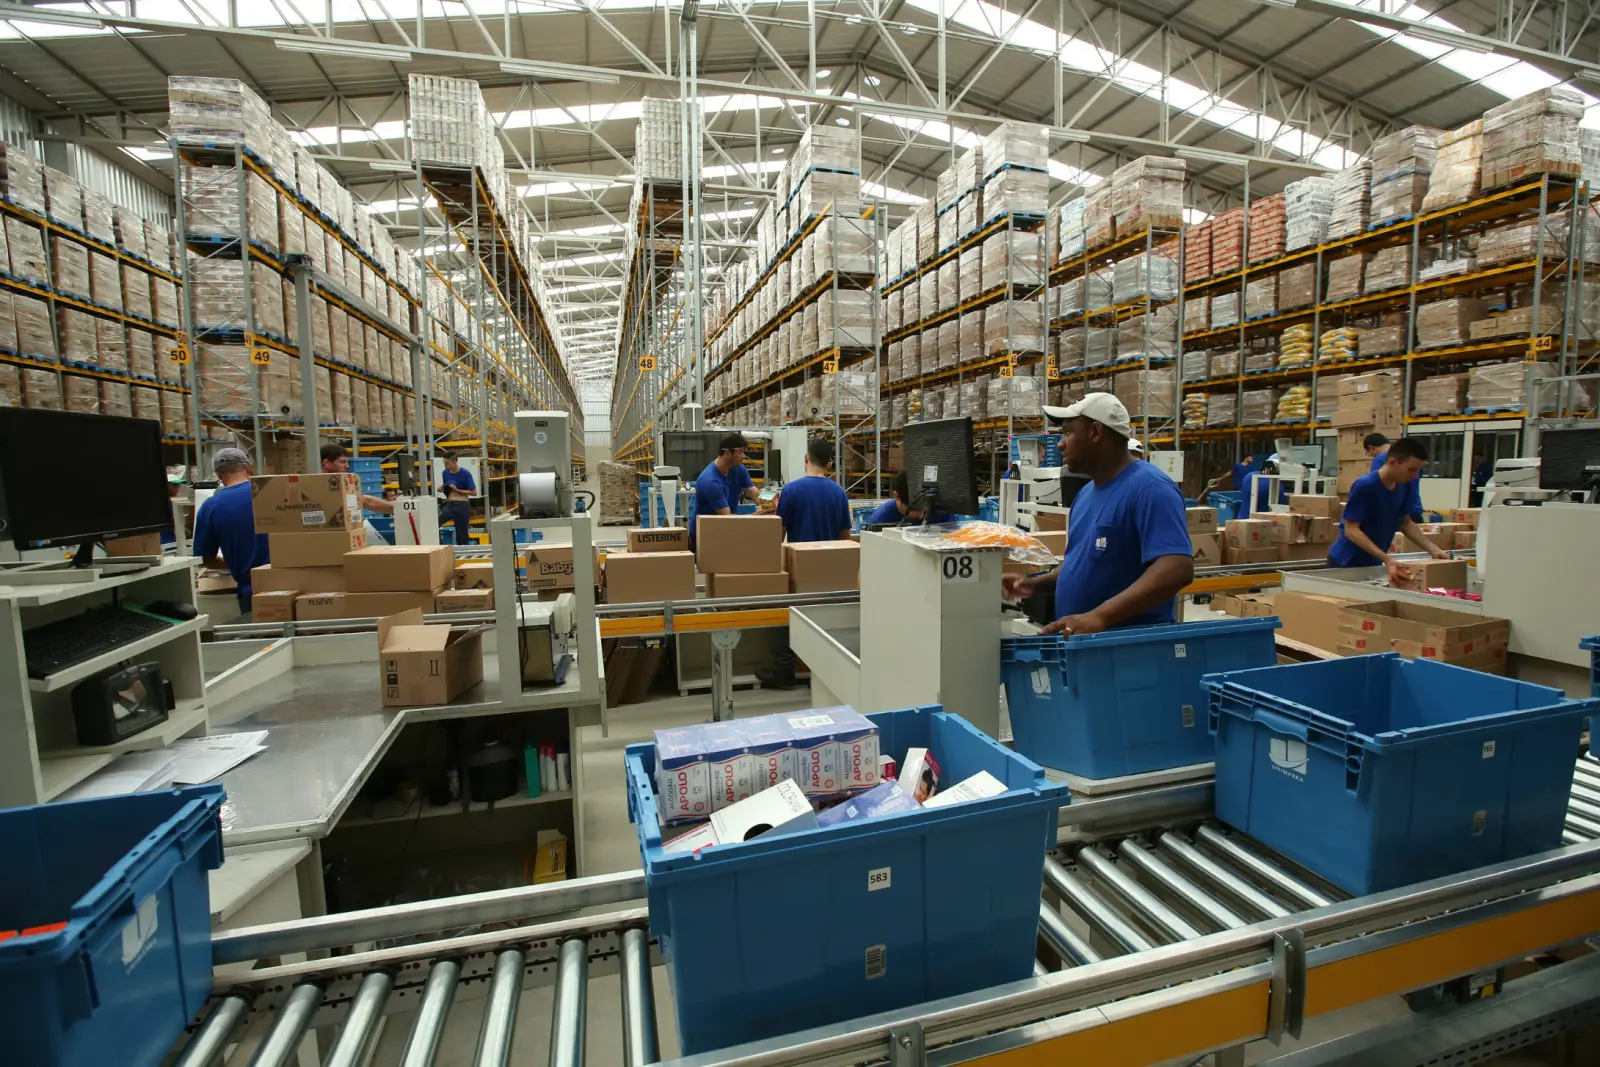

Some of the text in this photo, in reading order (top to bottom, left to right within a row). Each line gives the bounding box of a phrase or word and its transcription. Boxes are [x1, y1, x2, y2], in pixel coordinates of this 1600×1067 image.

[1536, 339, 1550, 348] 44
[170, 350, 186, 361] 50
[254, 351, 269, 362] 49
[640, 359, 652, 368] 48
[824, 362, 835, 371] 47
[1001, 368, 1010, 376] 46
[1048, 369, 1057, 377] 45
[403, 501, 416, 511] 01
[637, 532, 682, 543] LISTERINE
[540, 561, 574, 576] Baby
[943, 555, 973, 579] 08
[852, 744, 862, 781] APOLO
[768, 757, 778, 788] POLO
[811, 751, 821, 788] APOLO
[1271, 764, 1304, 783] UNIMARKA
[724, 764, 736, 802] APOLO
[678, 771, 690, 811] APOLO
[870, 872, 888, 884] 583
